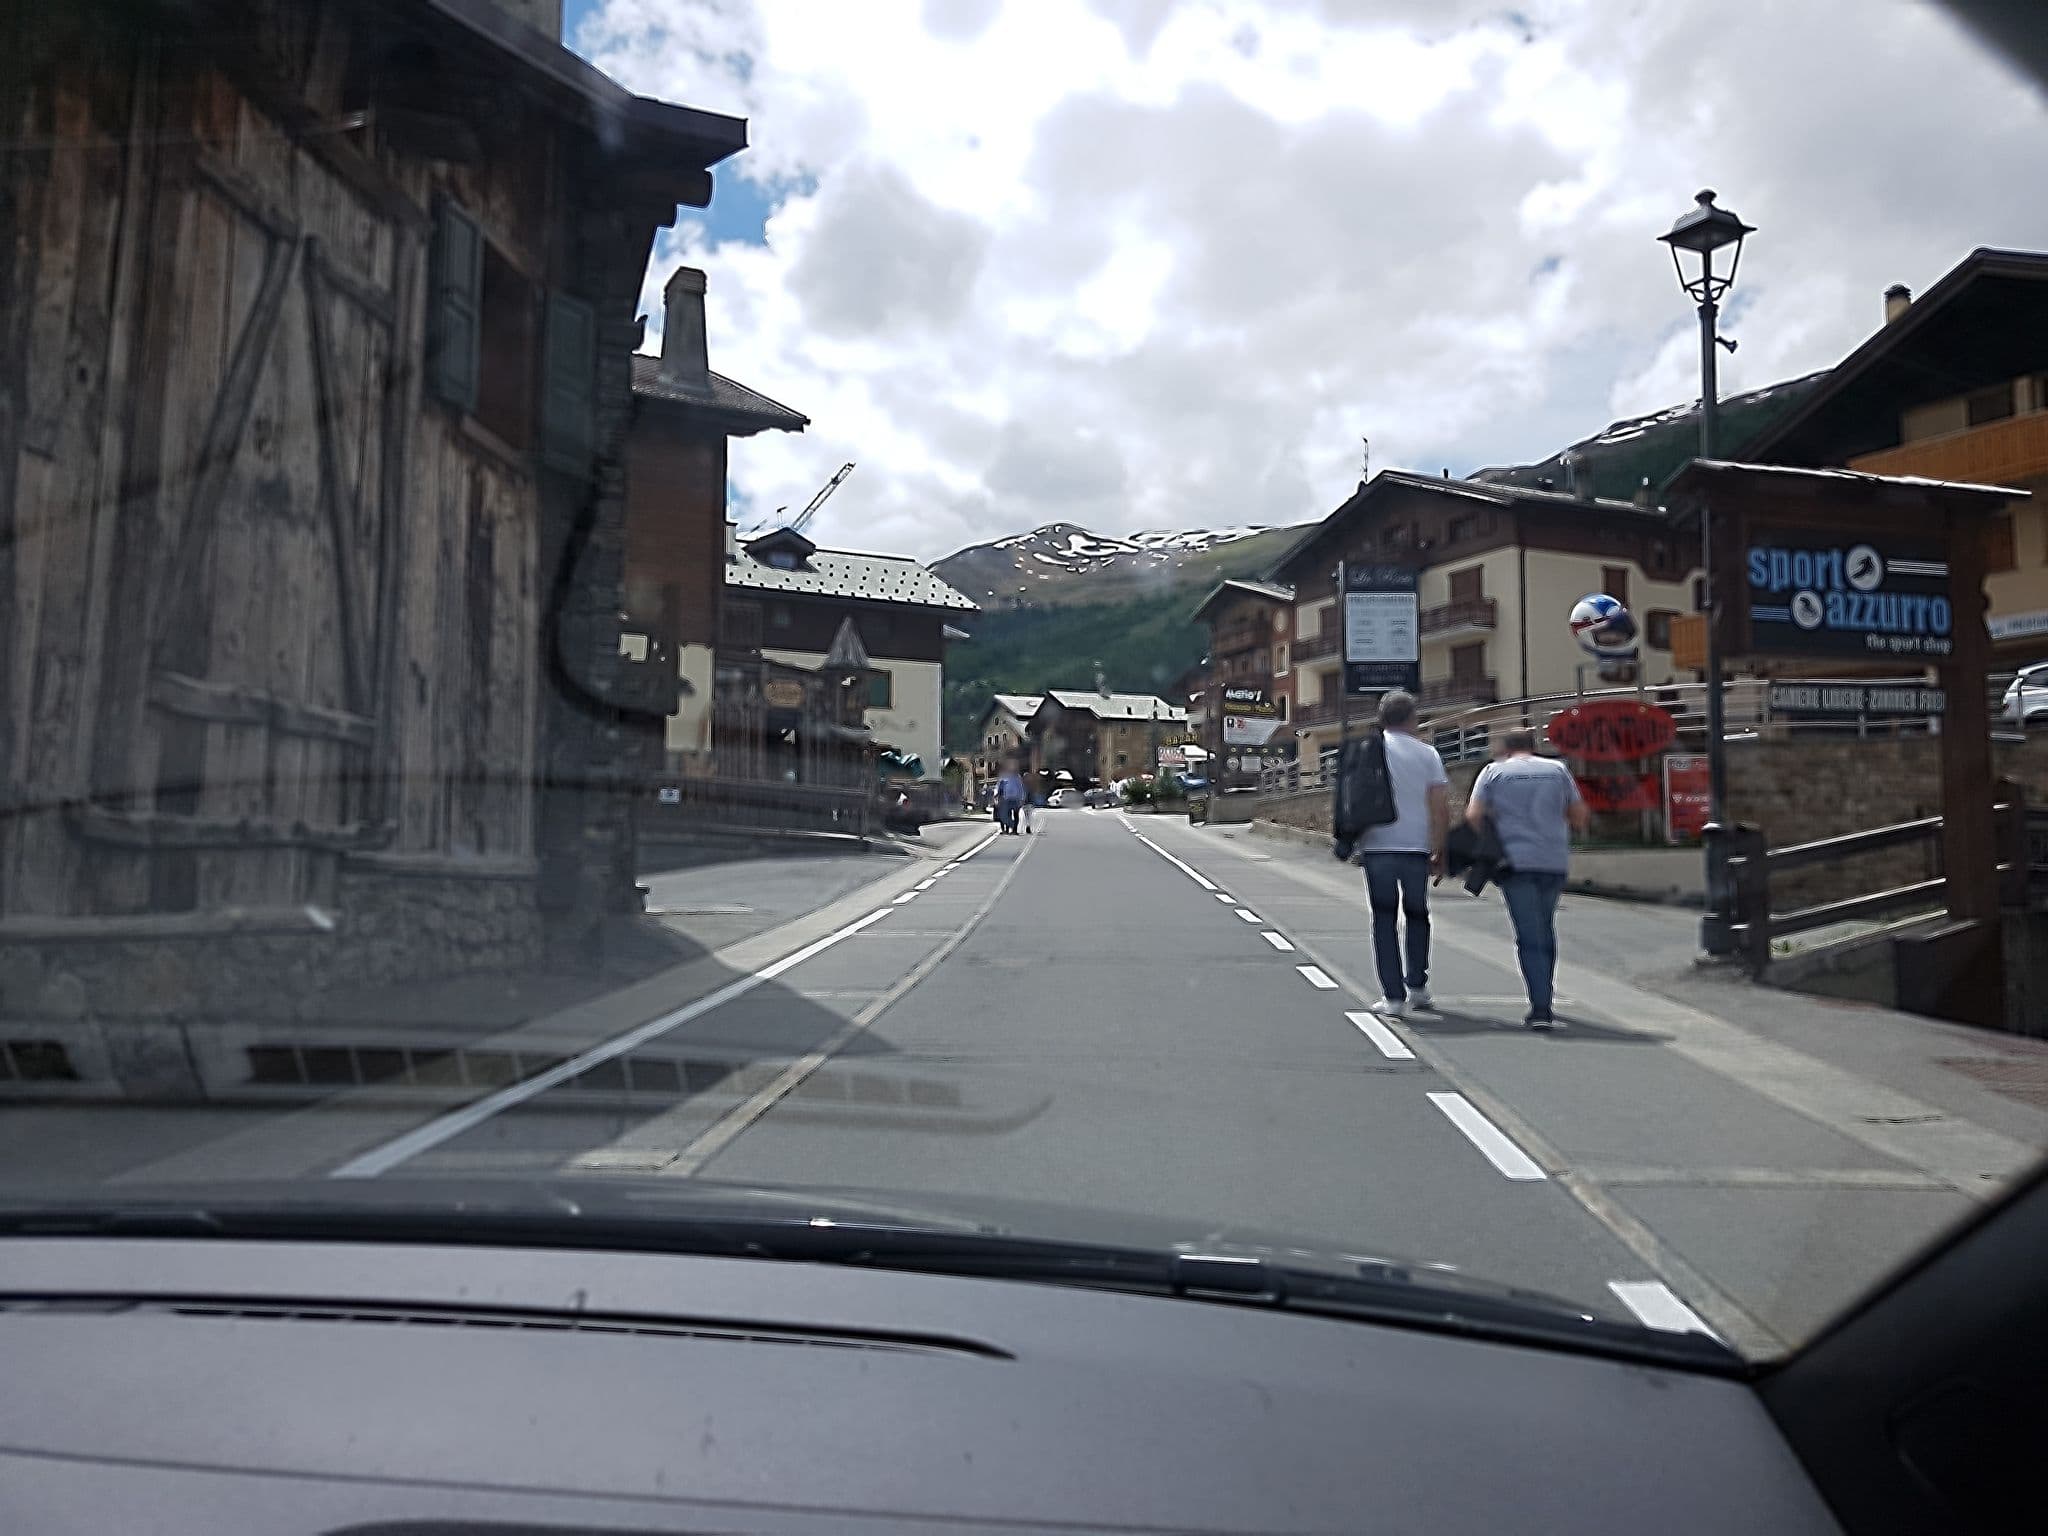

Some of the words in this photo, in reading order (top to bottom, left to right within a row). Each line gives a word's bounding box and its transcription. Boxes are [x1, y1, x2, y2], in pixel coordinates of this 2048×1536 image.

[1747, 547, 1847, 592] sport
[1825, 591, 1952, 635] azzurro
[1866, 633, 1887, 650] the
